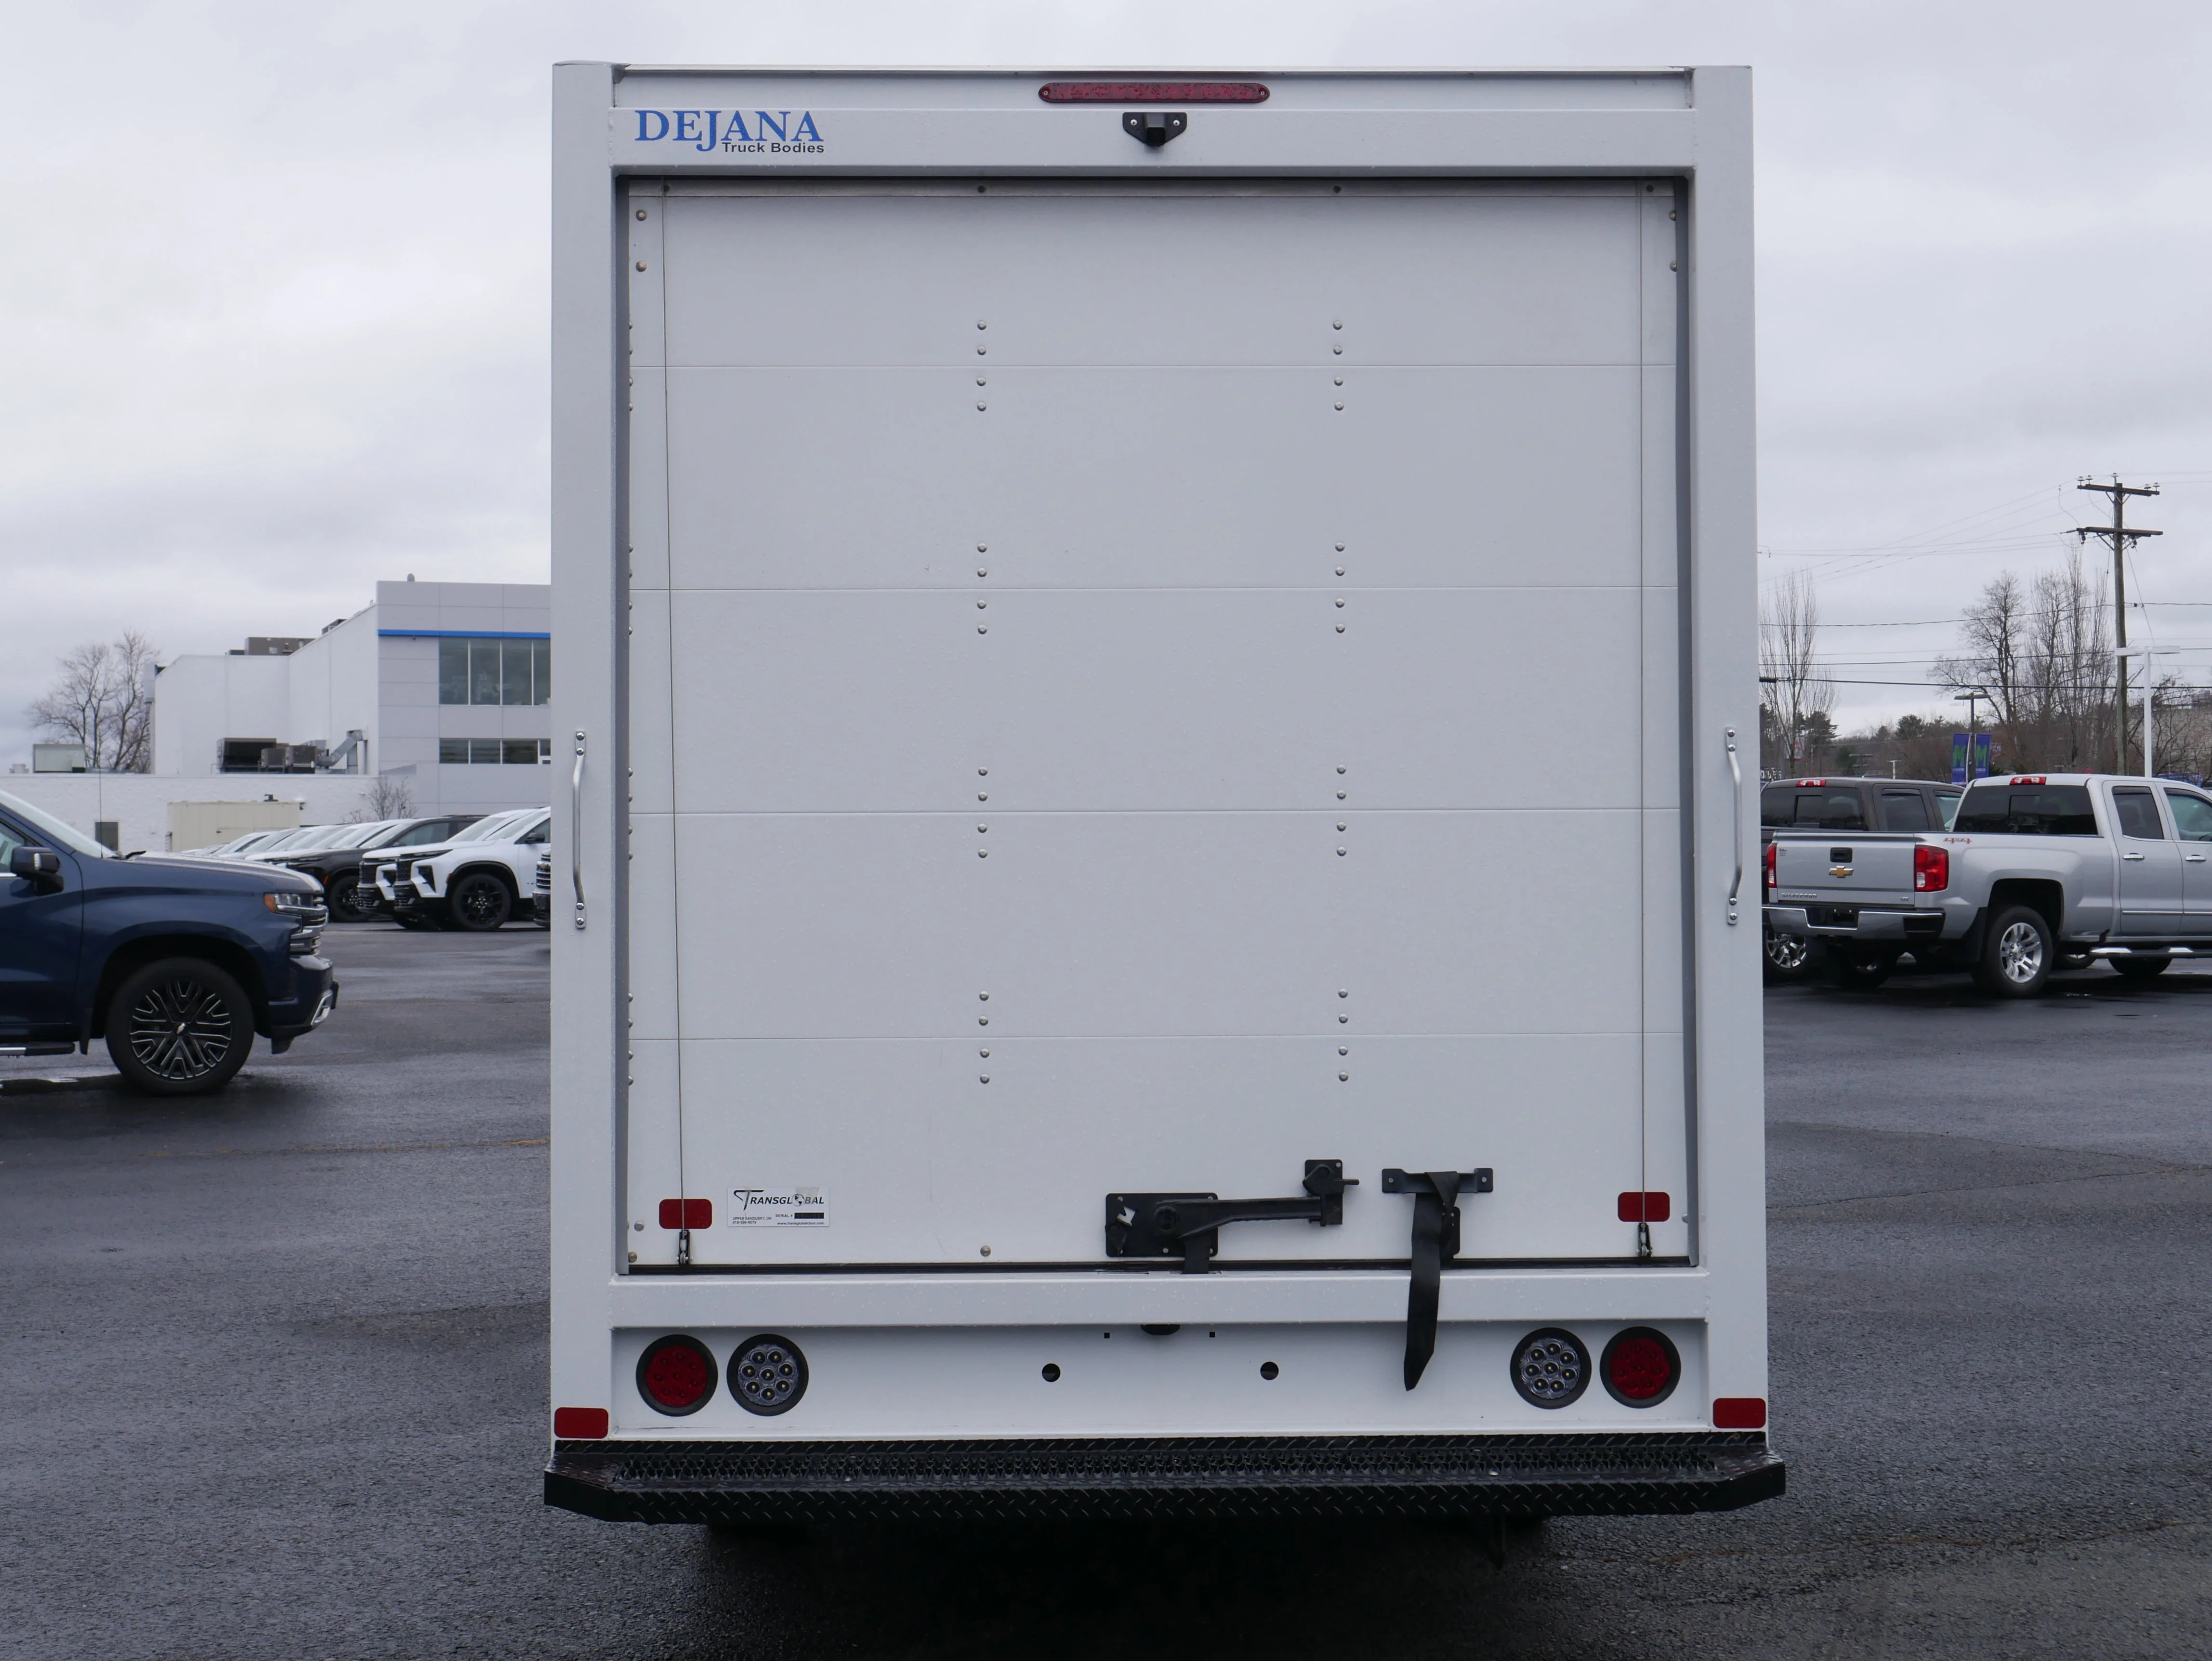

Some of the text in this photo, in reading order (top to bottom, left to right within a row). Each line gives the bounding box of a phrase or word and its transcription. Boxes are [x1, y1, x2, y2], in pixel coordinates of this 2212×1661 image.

[635, 110, 824, 152] DEJANA
[722, 142, 824, 153] Truck Bodies
